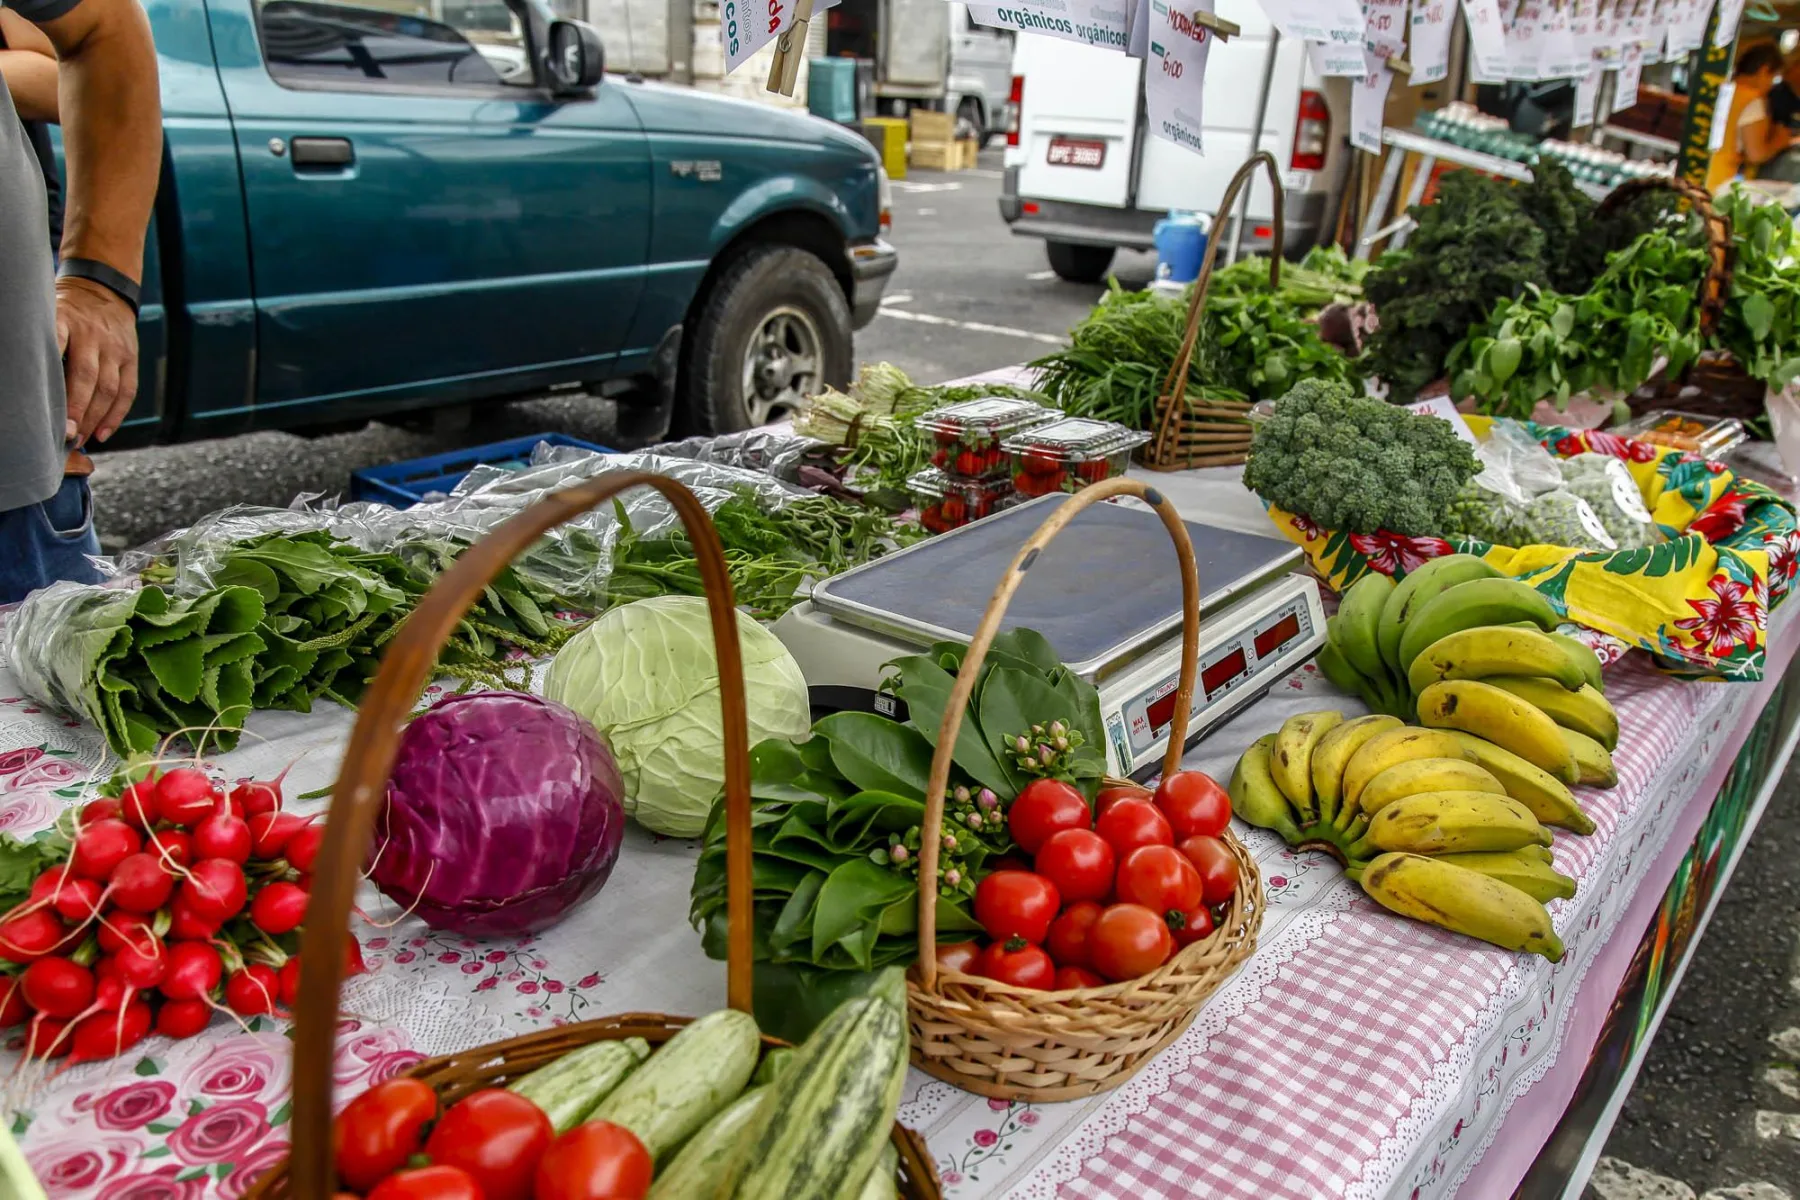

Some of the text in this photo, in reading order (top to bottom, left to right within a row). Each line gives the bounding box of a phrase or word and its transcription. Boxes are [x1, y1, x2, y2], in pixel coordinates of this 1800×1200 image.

[725, 0, 739, 56] cos
[997, 7, 1072, 34] orgânicos
[1076, 23, 1127, 46] orgânicos
[1163, 120, 1201, 149] orgânicos
[1132, 716, 1145, 727] MAX
